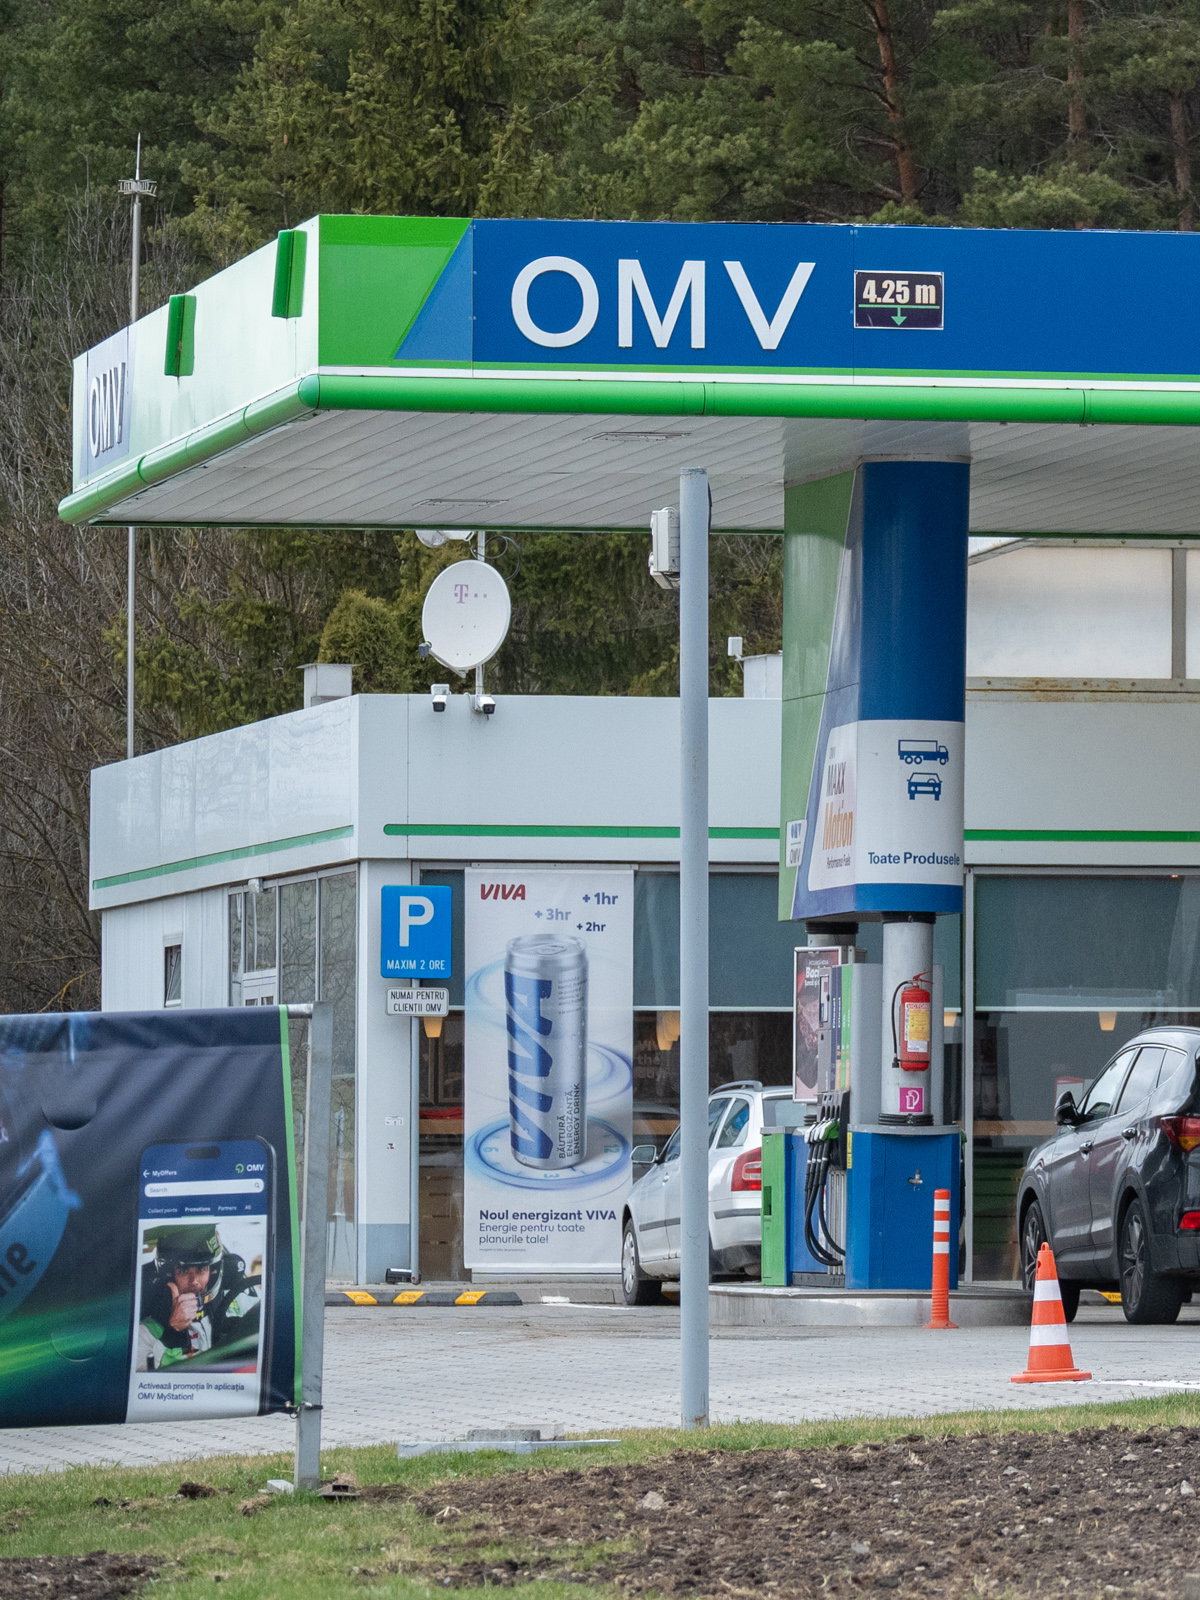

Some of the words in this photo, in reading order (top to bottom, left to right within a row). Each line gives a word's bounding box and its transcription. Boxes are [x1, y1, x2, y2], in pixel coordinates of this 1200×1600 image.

[862, 279, 910, 304] 4.25
[915, 284, 936, 305] m
[511, 255, 816, 350] OMV
[89, 362, 126, 458] OMV
[826, 762, 847, 796] MAXX
[823, 800, 853, 850] Motion
[868, 852, 900, 865] Toate
[904, 852, 961, 866] Produsele
[480, 884, 526, 901] VIVA
[594, 892, 618, 905] 1hr
[546, 908, 571, 921] 3hr
[399, 895, 434, 947] P
[585, 922, 606, 932] 2hr
[386, 959, 417, 971] MAXIM
[420, 960, 426, 970] 2
[429, 960, 446, 970] ORE
[390, 991, 413, 1000] NUMAI
[416, 991, 445, 1001] PENTRU
[425, 1003, 442, 1012] OMV
[504, 971, 553, 1160] VIVA
[152, 1169, 177, 1178] MyOffers
[246, 1164, 264, 1172] OMV
[480, 1210, 508, 1220] Noul
[512, 1210, 582, 1222] energizant
[586, 1210, 617, 1220] VIVA
[480, 1223, 517, 1234] Energie
[520, 1223, 554, 1235] pentru
[557, 1224, 585, 1233] toate
[479, 1235, 523, 1245] planurile
[526, 1235, 549, 1244] tale!
[138, 1382, 172, 1391] Activează
[156, 1392, 194, 1402] MyStation!
